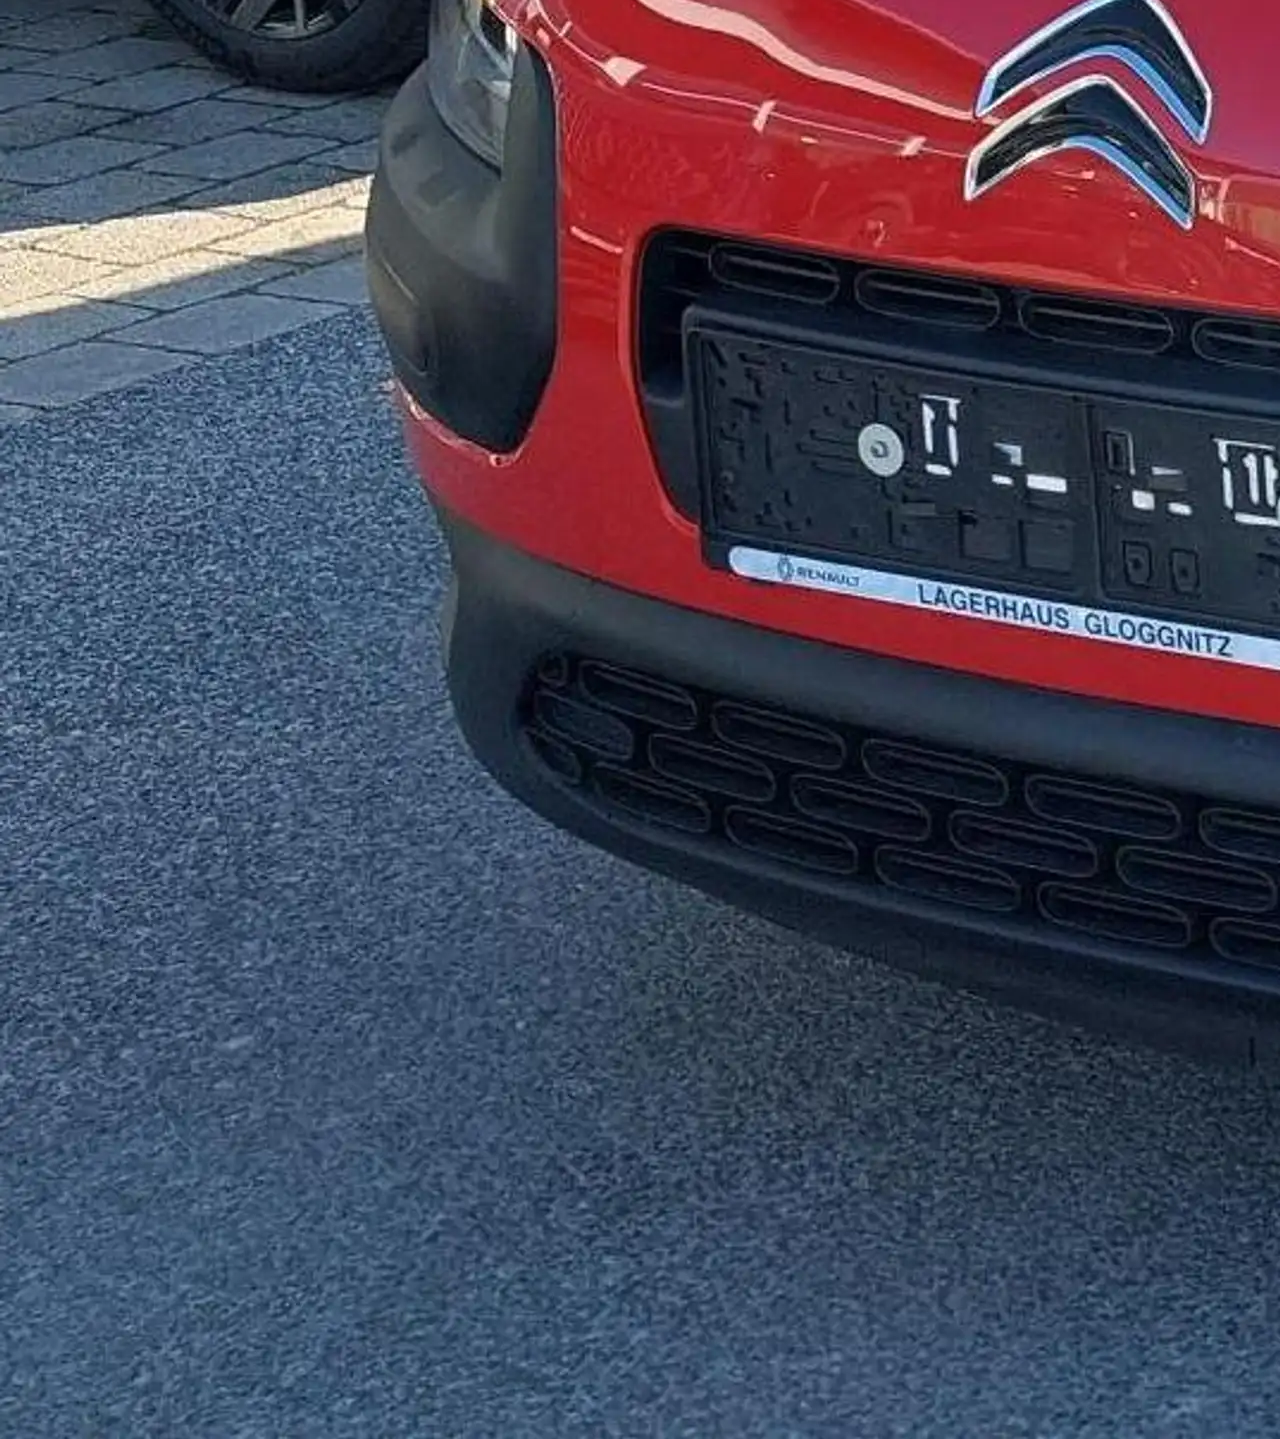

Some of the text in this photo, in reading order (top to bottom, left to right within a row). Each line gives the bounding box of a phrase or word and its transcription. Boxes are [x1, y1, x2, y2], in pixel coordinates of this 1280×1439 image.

[795, 565, 860, 588] RENAULT
[916, 582, 1234, 658] LAGERHAUS GLOGGNITZ
